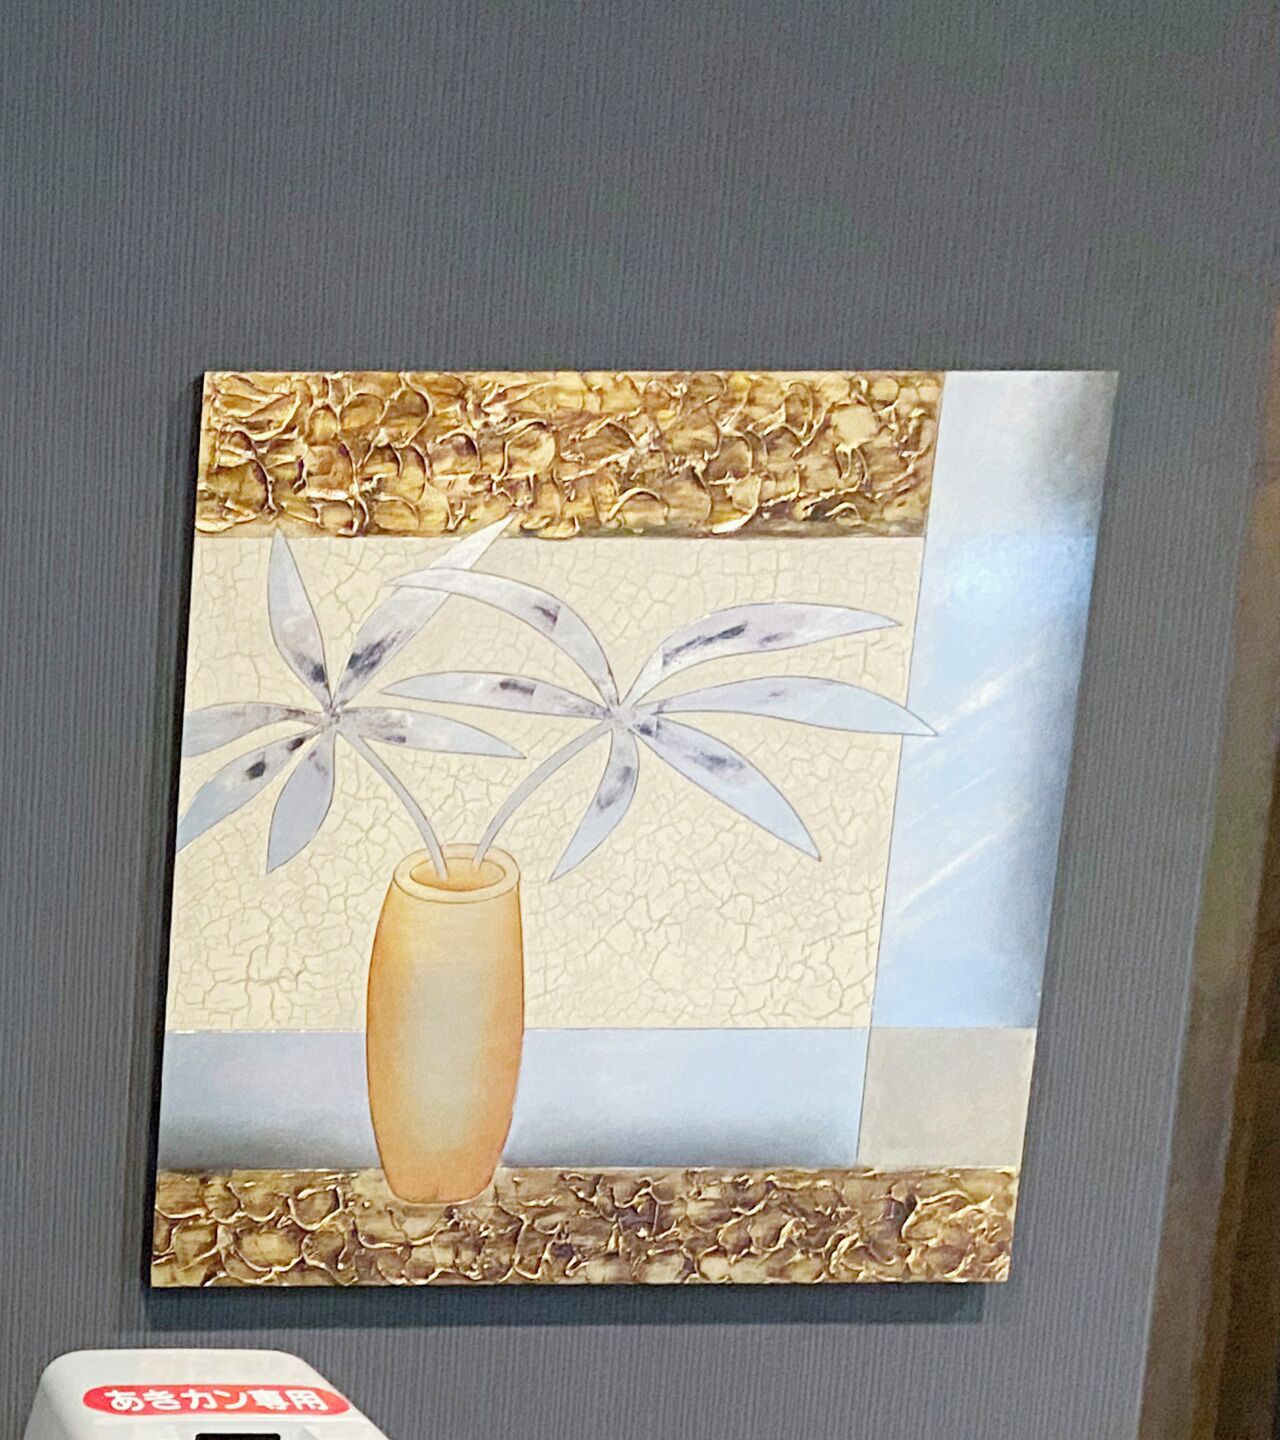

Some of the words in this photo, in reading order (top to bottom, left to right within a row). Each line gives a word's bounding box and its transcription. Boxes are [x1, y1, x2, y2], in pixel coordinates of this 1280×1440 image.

[105, 1388, 329, 1412] あきカン専用
